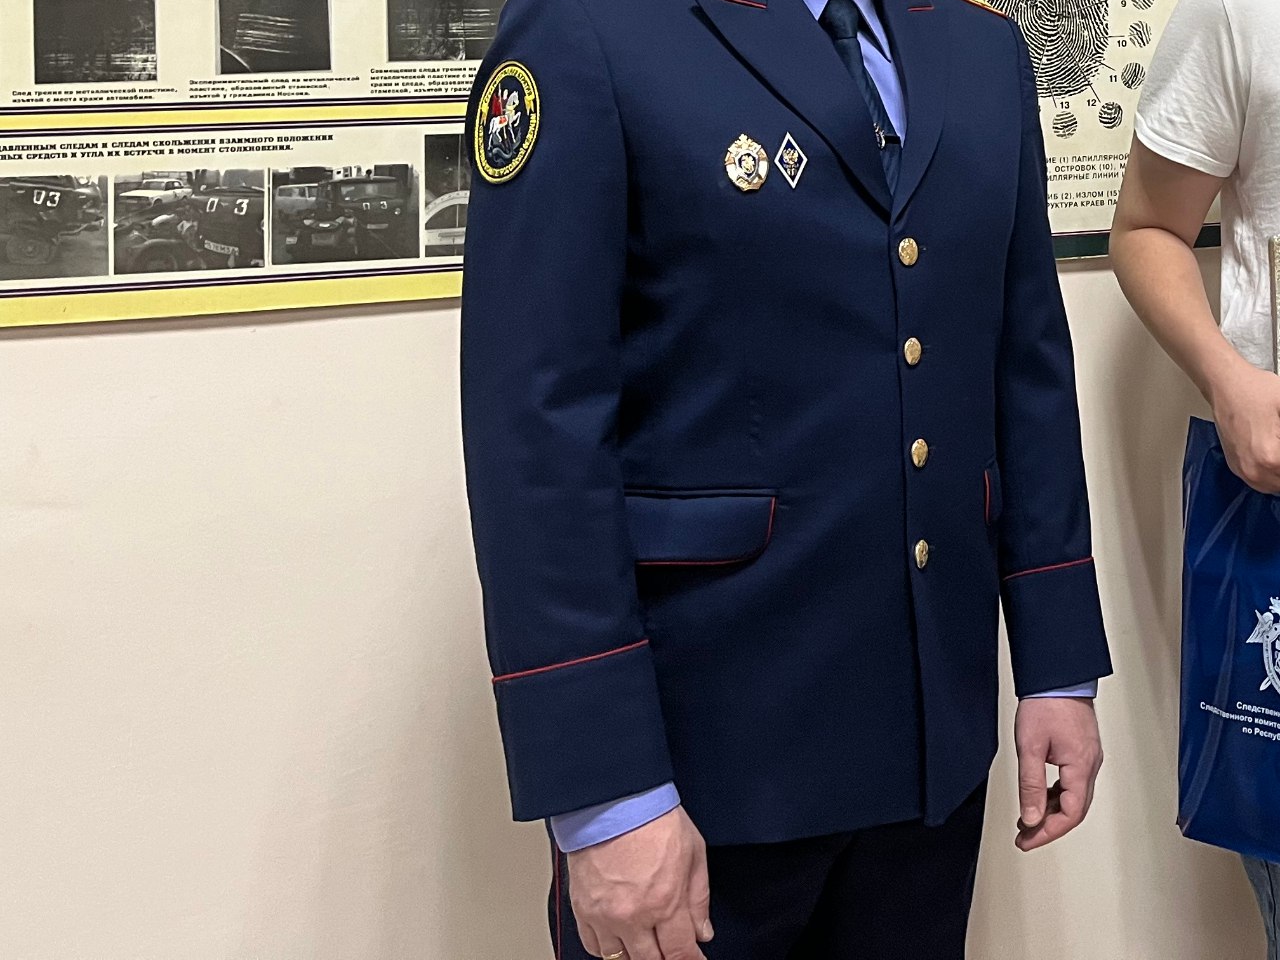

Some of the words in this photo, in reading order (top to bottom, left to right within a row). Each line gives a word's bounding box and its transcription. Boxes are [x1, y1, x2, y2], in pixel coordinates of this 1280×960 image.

[1121, 0, 1127, 8] 9
[1117, 40, 1127, 48] 10
[1060, 101, 1070, 109] 13
[1086, 99, 1097, 107] 12
[59, 142, 98, 150] СЛЕДАМ
[101, 141, 107, 149] И
[111, 140, 149, 149] СЛЕДАМ
[152, 138, 216, 147] СКОЛЬЖЕНИЯ
[219, 136, 274, 144] ВЗАИМНОГО
[276, 134, 333, 142] ПОЛОЖЕНИЯ
[1199, 701, 1253, 723] Следственного
[1242, 726, 1252, 734] по
